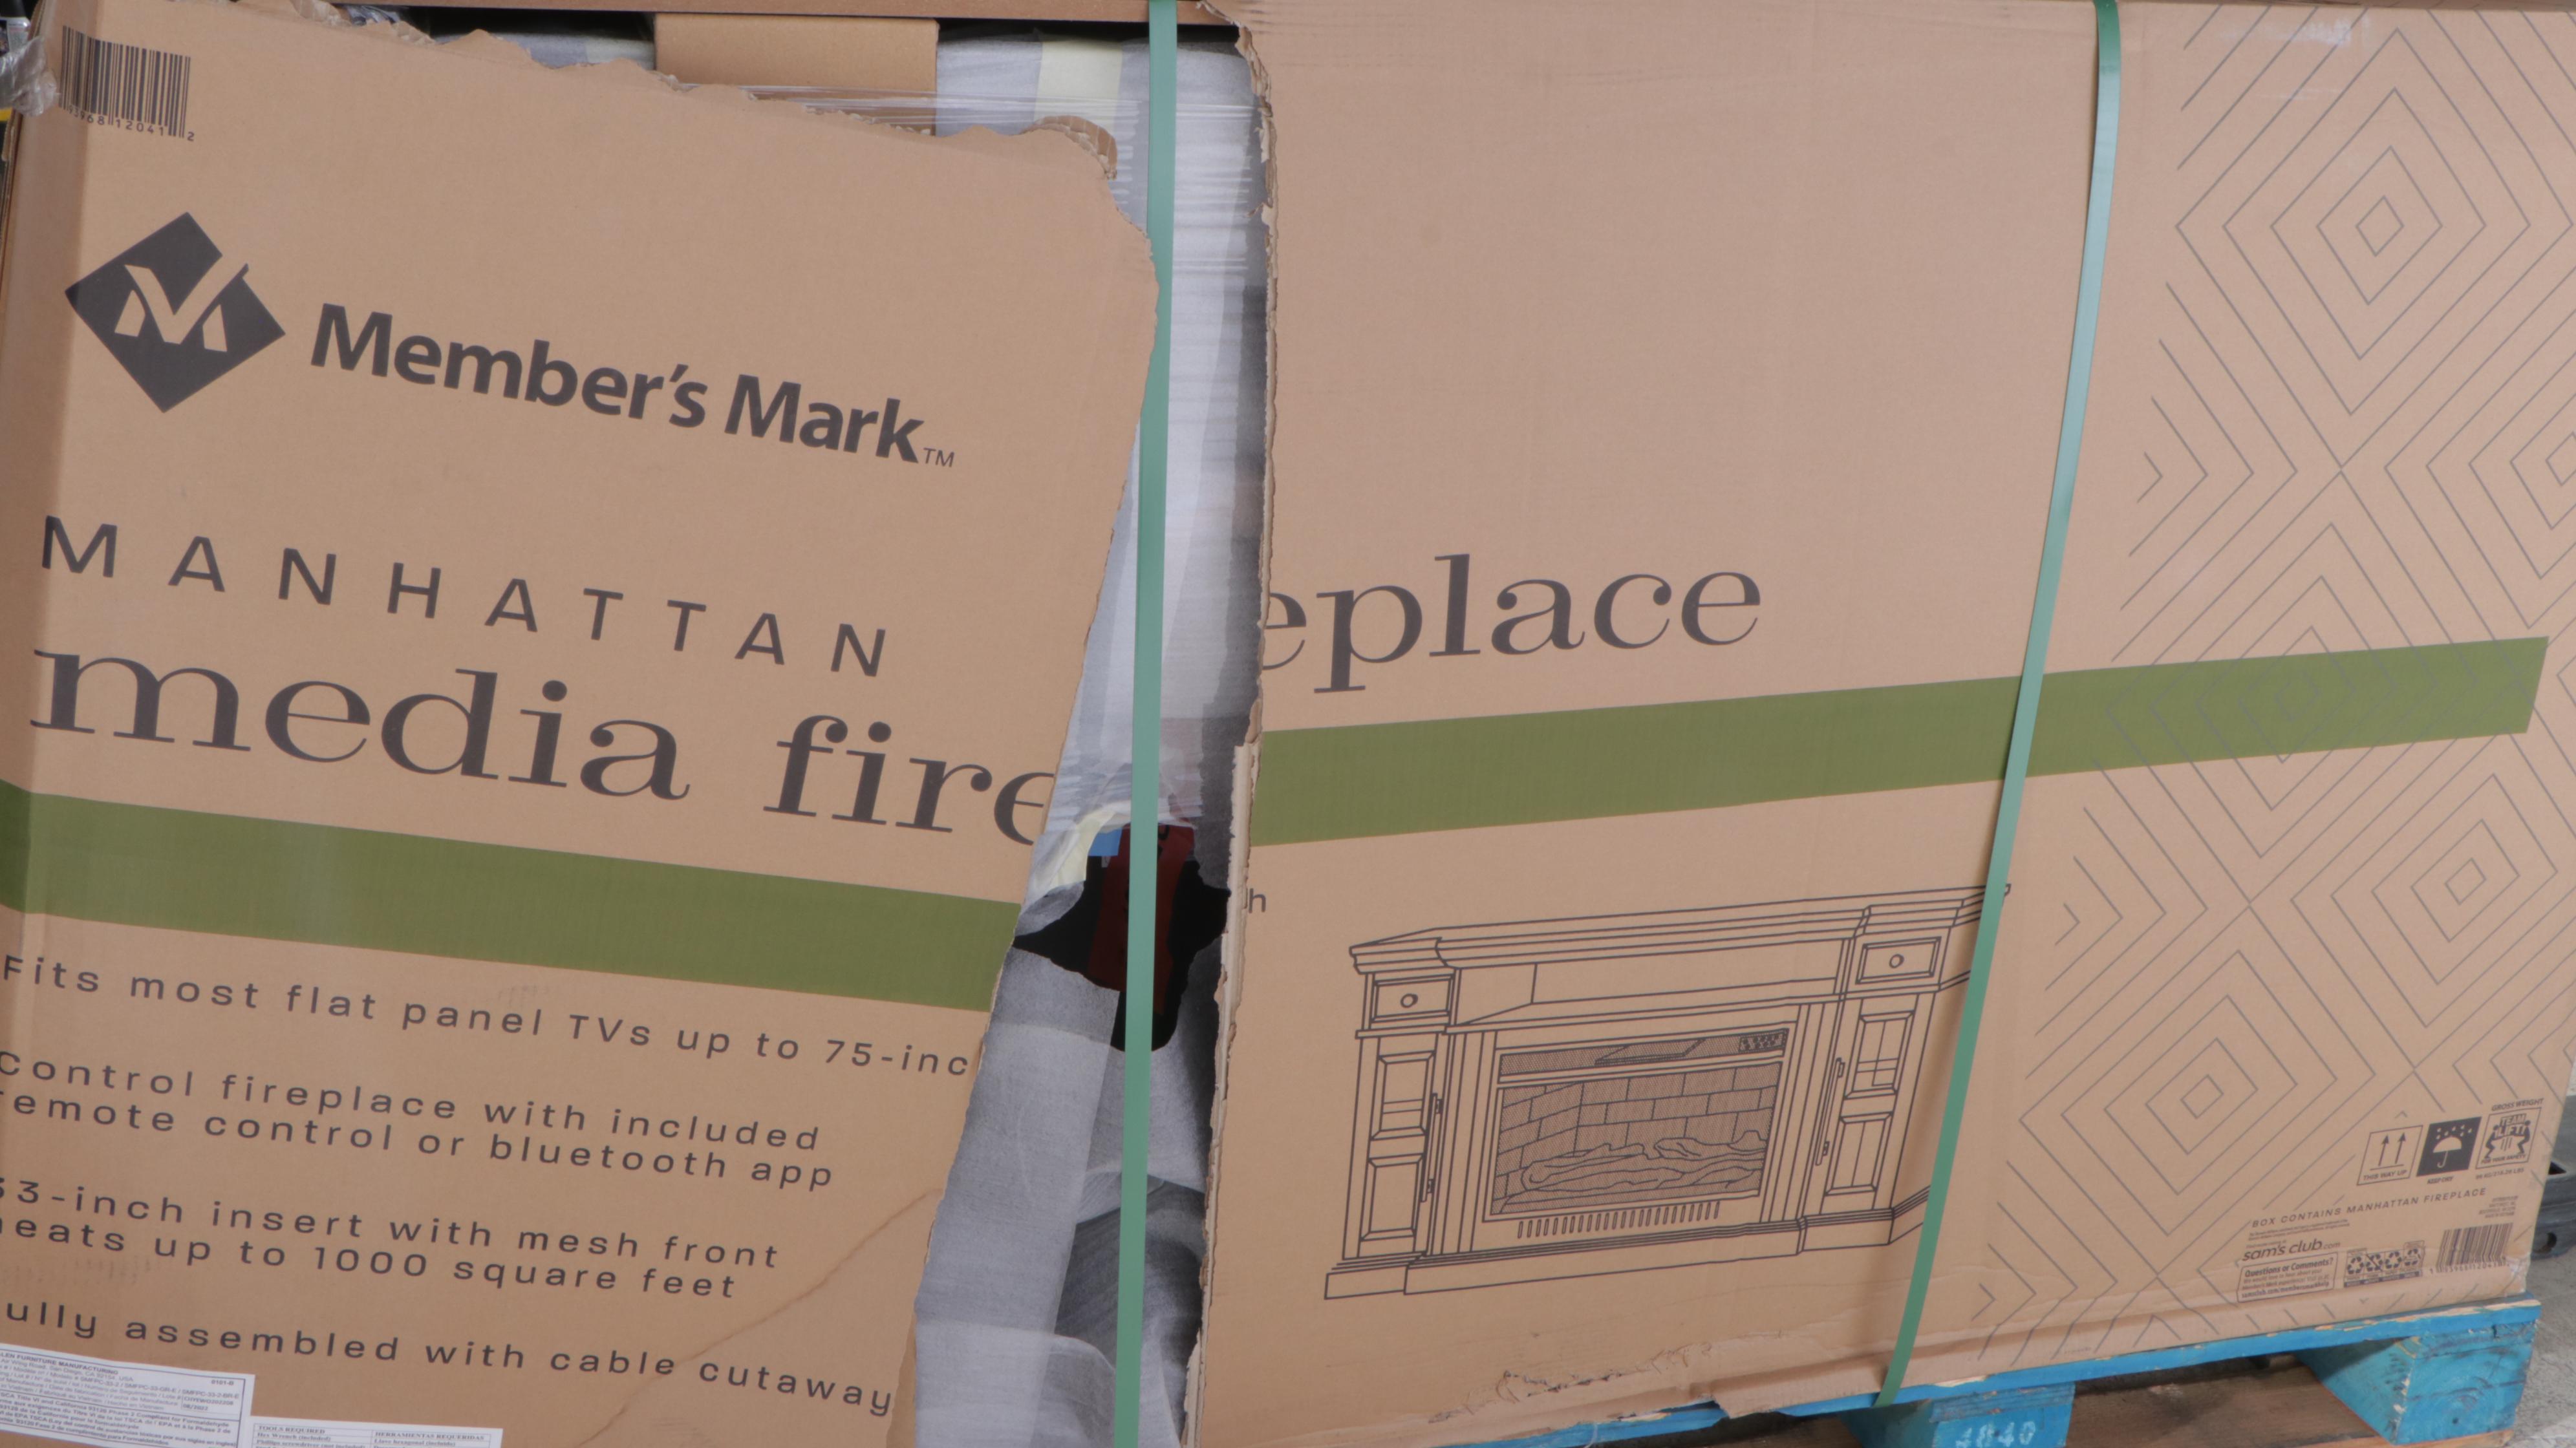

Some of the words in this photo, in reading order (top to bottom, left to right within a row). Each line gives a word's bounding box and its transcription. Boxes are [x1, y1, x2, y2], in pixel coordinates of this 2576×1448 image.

[115, 118, 164, 136] 12041
[187, 131, 195, 142] 2
[310, 303, 708, 428] Member's
[724, 374, 924, 464] Mark
[42, 515, 885, 677] MANHATTAN
[30, 649, 690, 800] media
[3, 955, 99, 992] Fits
[131, 976, 259, 1008] most
[287, 985, 376, 1020] flat
[402, 1002, 541, 1036] panel
[568, 1014, 650, 1046] TVs
[676, 1028, 729, 1059] up
[756, 1032, 799, 1060] to
[826, 1039, 969, 1076] 75-inc
[0, 1050, 193, 1096] Control
[222, 1074, 455, 1119] fireplace
[485, 1100, 586, 1131] with
[612, 1109, 820, 1150] included
[2492, 1102, 2515, 1111] GROSS
[2516, 1098, 2544, 1107] WEIGHT
[2500, 1114, 2526, 1126] TEAM
[0, 1091, 175, 1132] emote
[205, 1114, 392, 1151] control
[418, 1134, 464, 1156] or
[489, 1134, 726, 1178] bluetooth
[751, 1162, 832, 1192] app
[0, 1178, 182, 1223] 3-inch
[211, 1200, 363, 1237] insert
[389, 1217, 492, 1247] with
[518, 1230, 639, 1258] mesh
[664, 1235, 778, 1269] front
[2251, 1217, 2276, 1228] BOX
[2281, 1208, 2341, 1223] CONTAINS
[2346, 1197, 2419, 1214] MANHATTAN
[2423, 1187, 2486, 1203] FIREPLACE
[0, 1218, 124, 1251] eats
[155, 1237, 211, 1266] up
[240, 1242, 285, 1266] to
[314, 1246, 427, 1277] 1000
[453, 1260, 617, 1290] square
[643, 1268, 735, 1299] feet
[2242, 1243, 2285, 1261] sam's
[2244, 1266, 2281, 1278] Questions
[2291, 1257, 2334, 1271] Comments?
[6, 1302, 96, 1339] ully
[125, 1320, 398, 1360] assembled
[424, 1341, 524, 1369] with
[550, 1350, 674, 1376] cable
[699, 1361, 892, 1417] cutaway
[17, 1354, 57, 1365] FURNITURE
[58, 1361, 119, 1375] MANUFACTURING
[56, 1401, 87, 1409] California
[136, 1412, 170, 1421] Compliant
[182, 1418, 230, 1427] Formaldehyde
[285, 1427, 325, 1435] REQUIRED
[298, 1434, 332, 1443] (included)
[436, 1432, 484, 1441] REQUERIDAS
